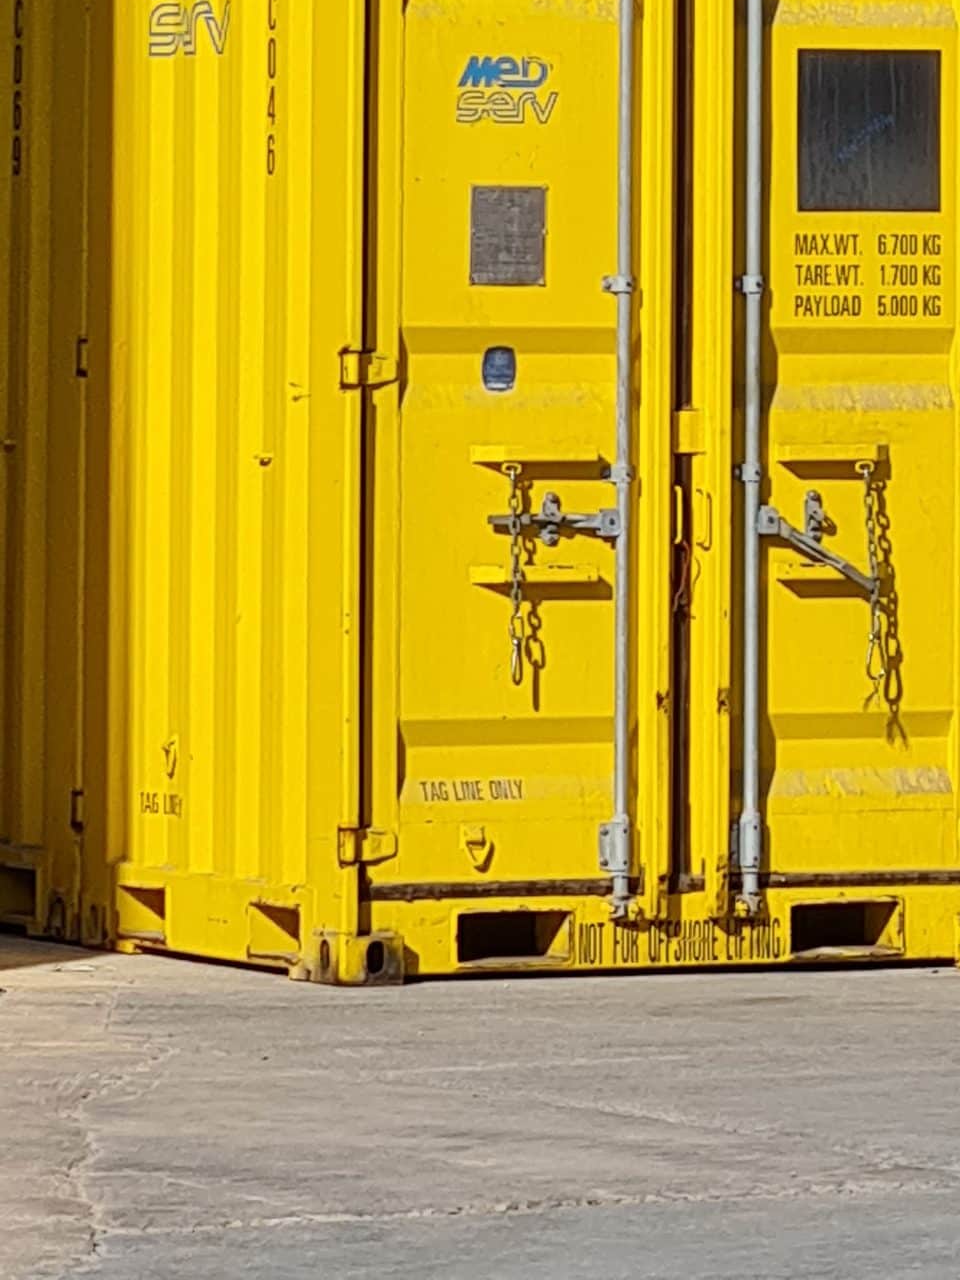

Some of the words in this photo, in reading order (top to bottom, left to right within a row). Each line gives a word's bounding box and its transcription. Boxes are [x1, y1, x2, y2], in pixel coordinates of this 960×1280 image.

[923, 234, 941, 255] KG
[923, 265, 941, 286] KG
[795, 295, 862, 317] PAYLOAD
[923, 295, 941, 317] KG
[420, 781, 449, 801] TAG
[452, 780, 484, 801] LINE
[489, 779, 522, 800] ONLY
[578, 922, 605, 965] NOT
[649, 919, 718, 963] OFFSHORE
